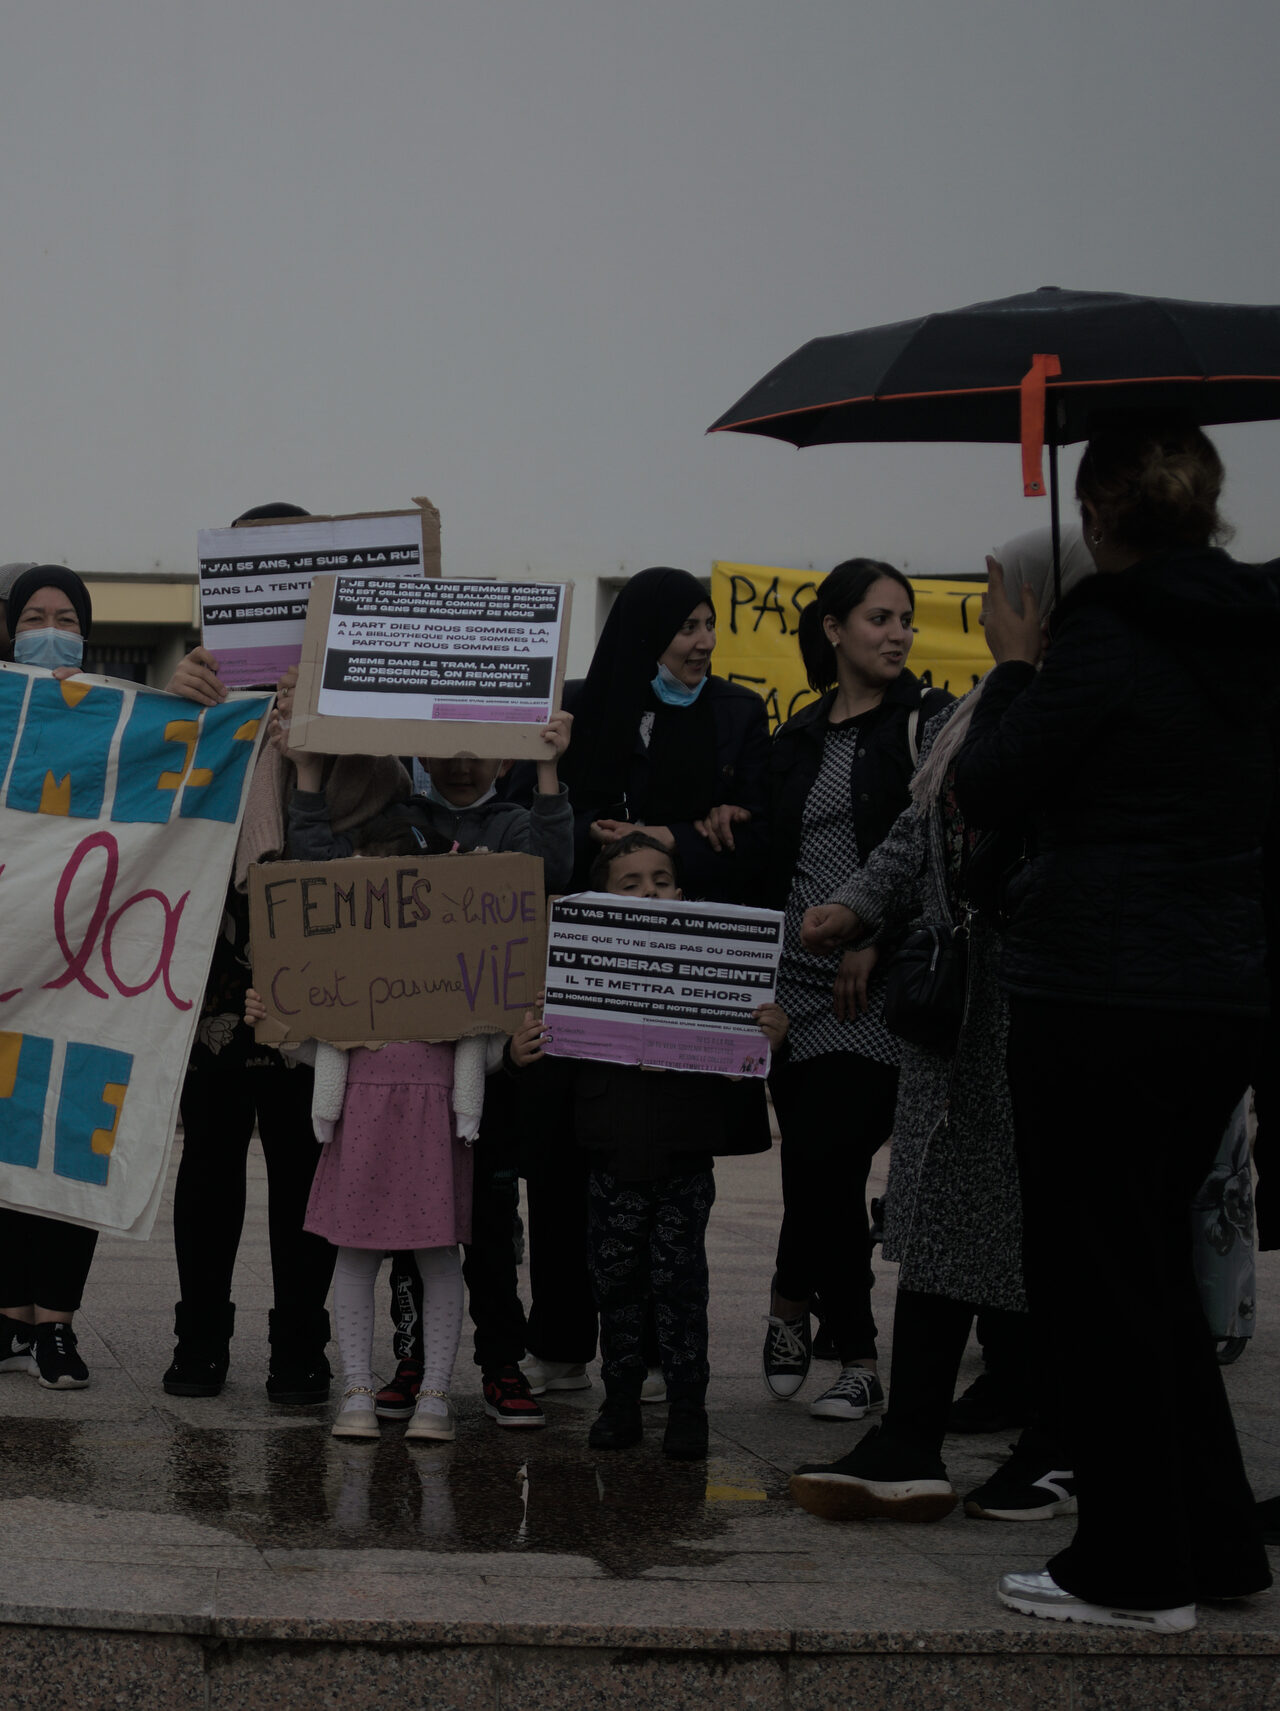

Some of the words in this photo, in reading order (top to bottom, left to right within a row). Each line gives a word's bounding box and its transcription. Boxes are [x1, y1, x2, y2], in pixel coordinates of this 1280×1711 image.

[236, 561, 254, 571] 55
[258, 559, 291, 569] ANS,
[294, 557, 313, 566] JE
[315, 555, 349, 566] SUIS
[352, 554, 363, 563] A
[367, 552, 386, 562] LA
[390, 550, 419, 560] RUE
[202, 586, 241, 596] DANS
[245, 585, 264, 593] LA
[367, 580, 396, 588] SUIS
[399, 582, 432, 590] DEJA
[434, 583, 461, 591] UNE
[463, 585, 509, 593] FEMME
[205, 609, 232, 619] J'AI
[235, 605, 288, 617] BESOIN
[351, 621, 386, 629] PART
[390, 623, 421, 631] DIEU
[424, 624, 461, 632] NOUS
[465, 626, 525, 634] SOMMES
[414, 641, 449, 650] NOUS
[453, 643, 510, 651] SOMMES
[347, 666, 367, 674] ON
[369, 667, 441, 678] DESCENDS,
[443, 670, 463, 678] ON
[465, 671, 529, 680] REMONTE
[348, 657, 385, 665] MEME
[387, 658, 420, 666] DANS
[440, 660, 478, 669] TRAM,
[499, 663, 530, 672] NUIT,
[343, 675, 376, 683] POUR
[378, 676, 428, 685] POUVOIR
[431, 679, 477, 687] DORMIR
[265, 868, 431, 938] FEMMES
[441, 891, 461, 924] à
[480, 890, 537, 925] RUE
[41, 831, 194, 1011] la
[581, 909, 605, 918] VAS
[607, 911, 623, 920] TE
[625, 913, 668, 925] LIVRER
[671, 918, 681, 927] A
[684, 919, 705, 928] UN
[707, 921, 777, 935] MONSIEUR
[553, 932, 588, 941] PARCE
[591, 935, 613, 943] QUE
[649, 941, 677, 950] SAIS
[680, 944, 703, 952] PAS
[706, 947, 723, 955] OU
[726, 949, 774, 960] DORMIR
[552, 951, 577, 963] TU
[580, 953, 674, 974] TOMBERAS
[678, 963, 772, 983] ENCEINTE
[565, 975, 579, 984] IL
[584, 976, 604, 987] TE
[608, 979, 675, 995] METTRA
[681, 987, 752, 1002] DEHORS
[368, 976, 421, 1031] pas
[423, 978, 466, 994] une
[547, 991, 564, 999] LES
[565, 993, 603, 1003] HOMMES
[604, 997, 650, 1009] PROFITENT
[666, 1004, 699, 1014] NOTRE
